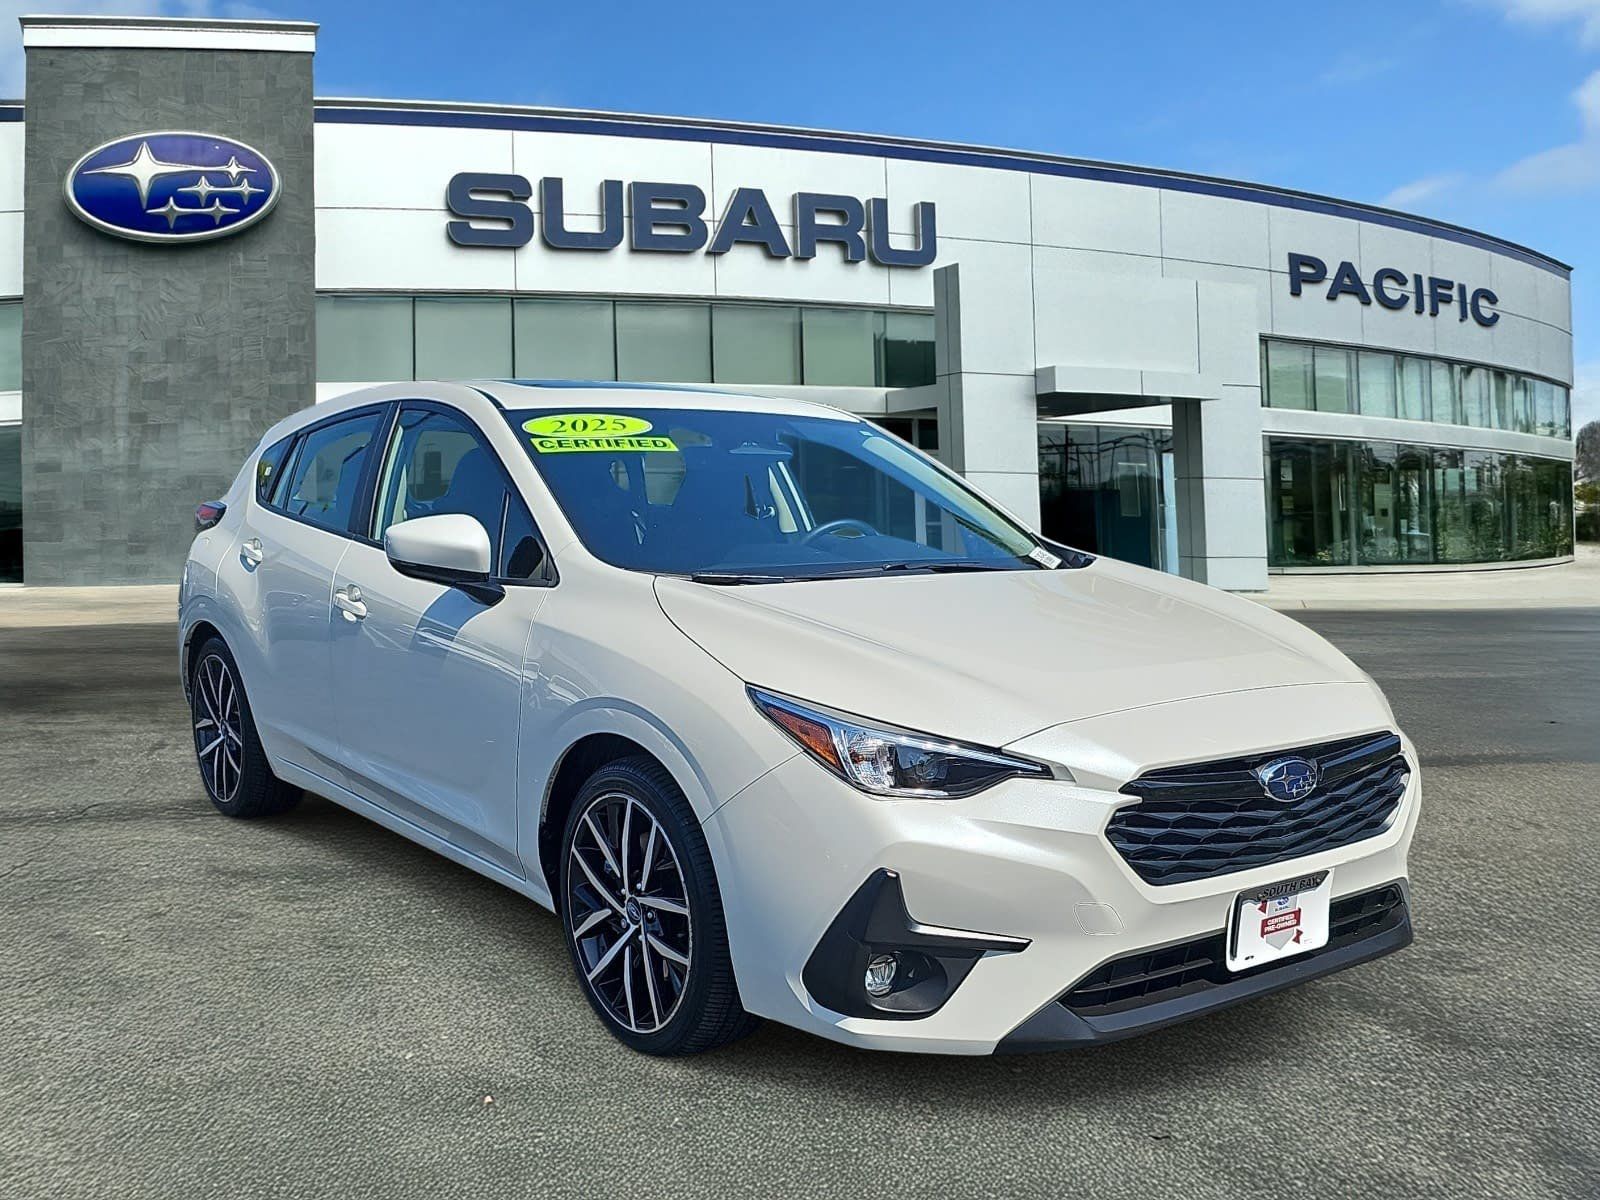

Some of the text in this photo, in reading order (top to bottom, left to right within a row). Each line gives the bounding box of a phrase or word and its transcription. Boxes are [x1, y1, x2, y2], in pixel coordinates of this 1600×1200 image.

[446, 171, 937, 268] SUBARU
[1287, 251, 1501, 327] PACIFIC
[551, 418, 627, 434] 2025
[538, 438, 668, 449] CERTIFIED
[1263, 881, 1297, 898] SOUTH
[1264, 919, 1297, 933] PRE-OWNED
[1267, 913, 1295, 926] CERTIFIED
